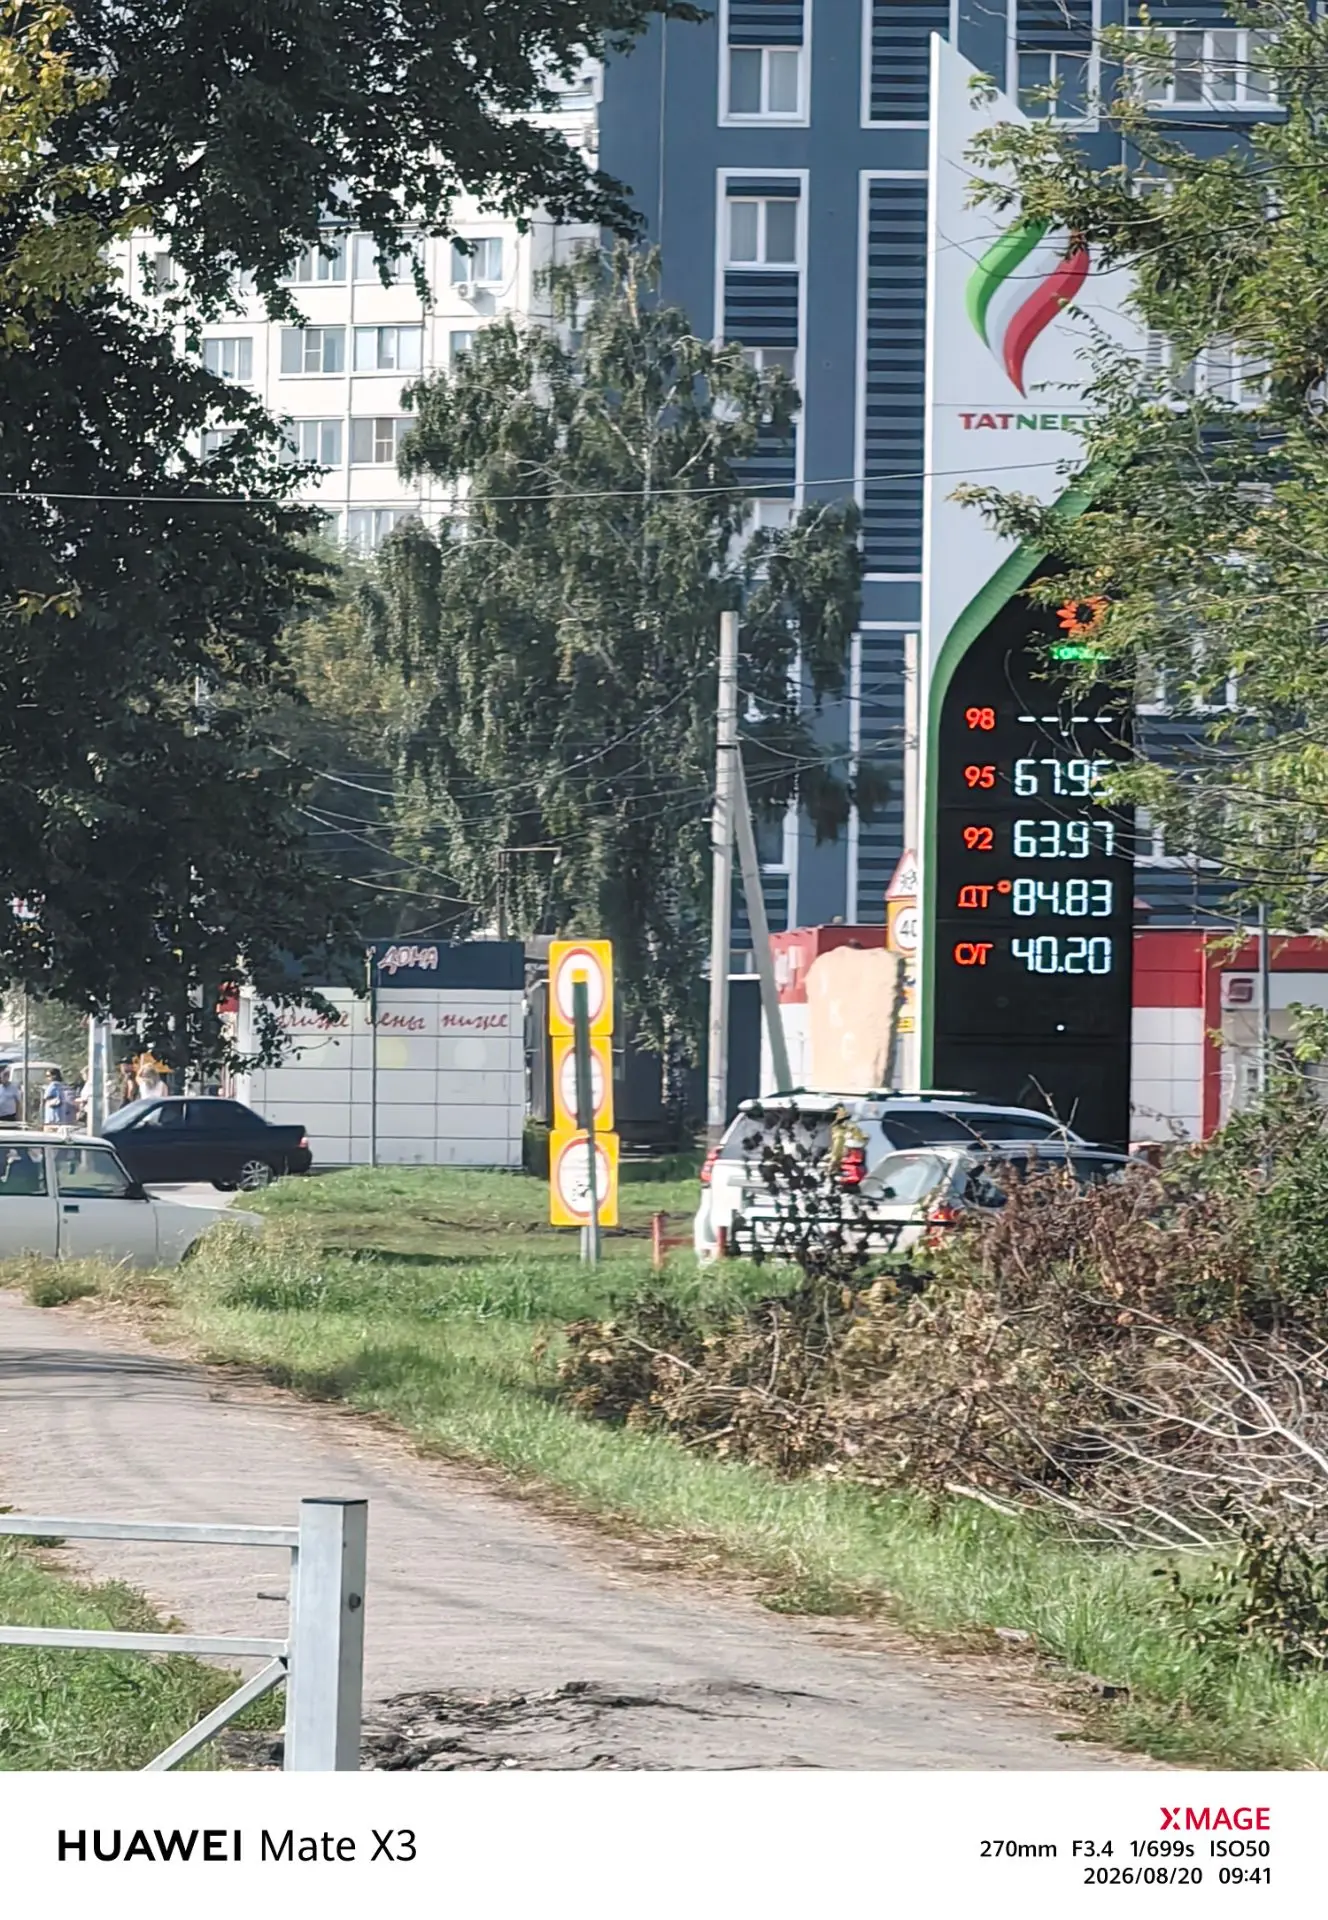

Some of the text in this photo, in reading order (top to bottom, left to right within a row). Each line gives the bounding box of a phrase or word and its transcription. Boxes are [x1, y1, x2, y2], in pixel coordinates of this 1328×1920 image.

[965, 707, 996, 731] 98
[964, 765, 996, 789] 95
[963, 819, 1115, 858] 92 63.97
[1012, 878, 1114, 917] 84.83
[954, 936, 1113, 974] СУГ 40.20
